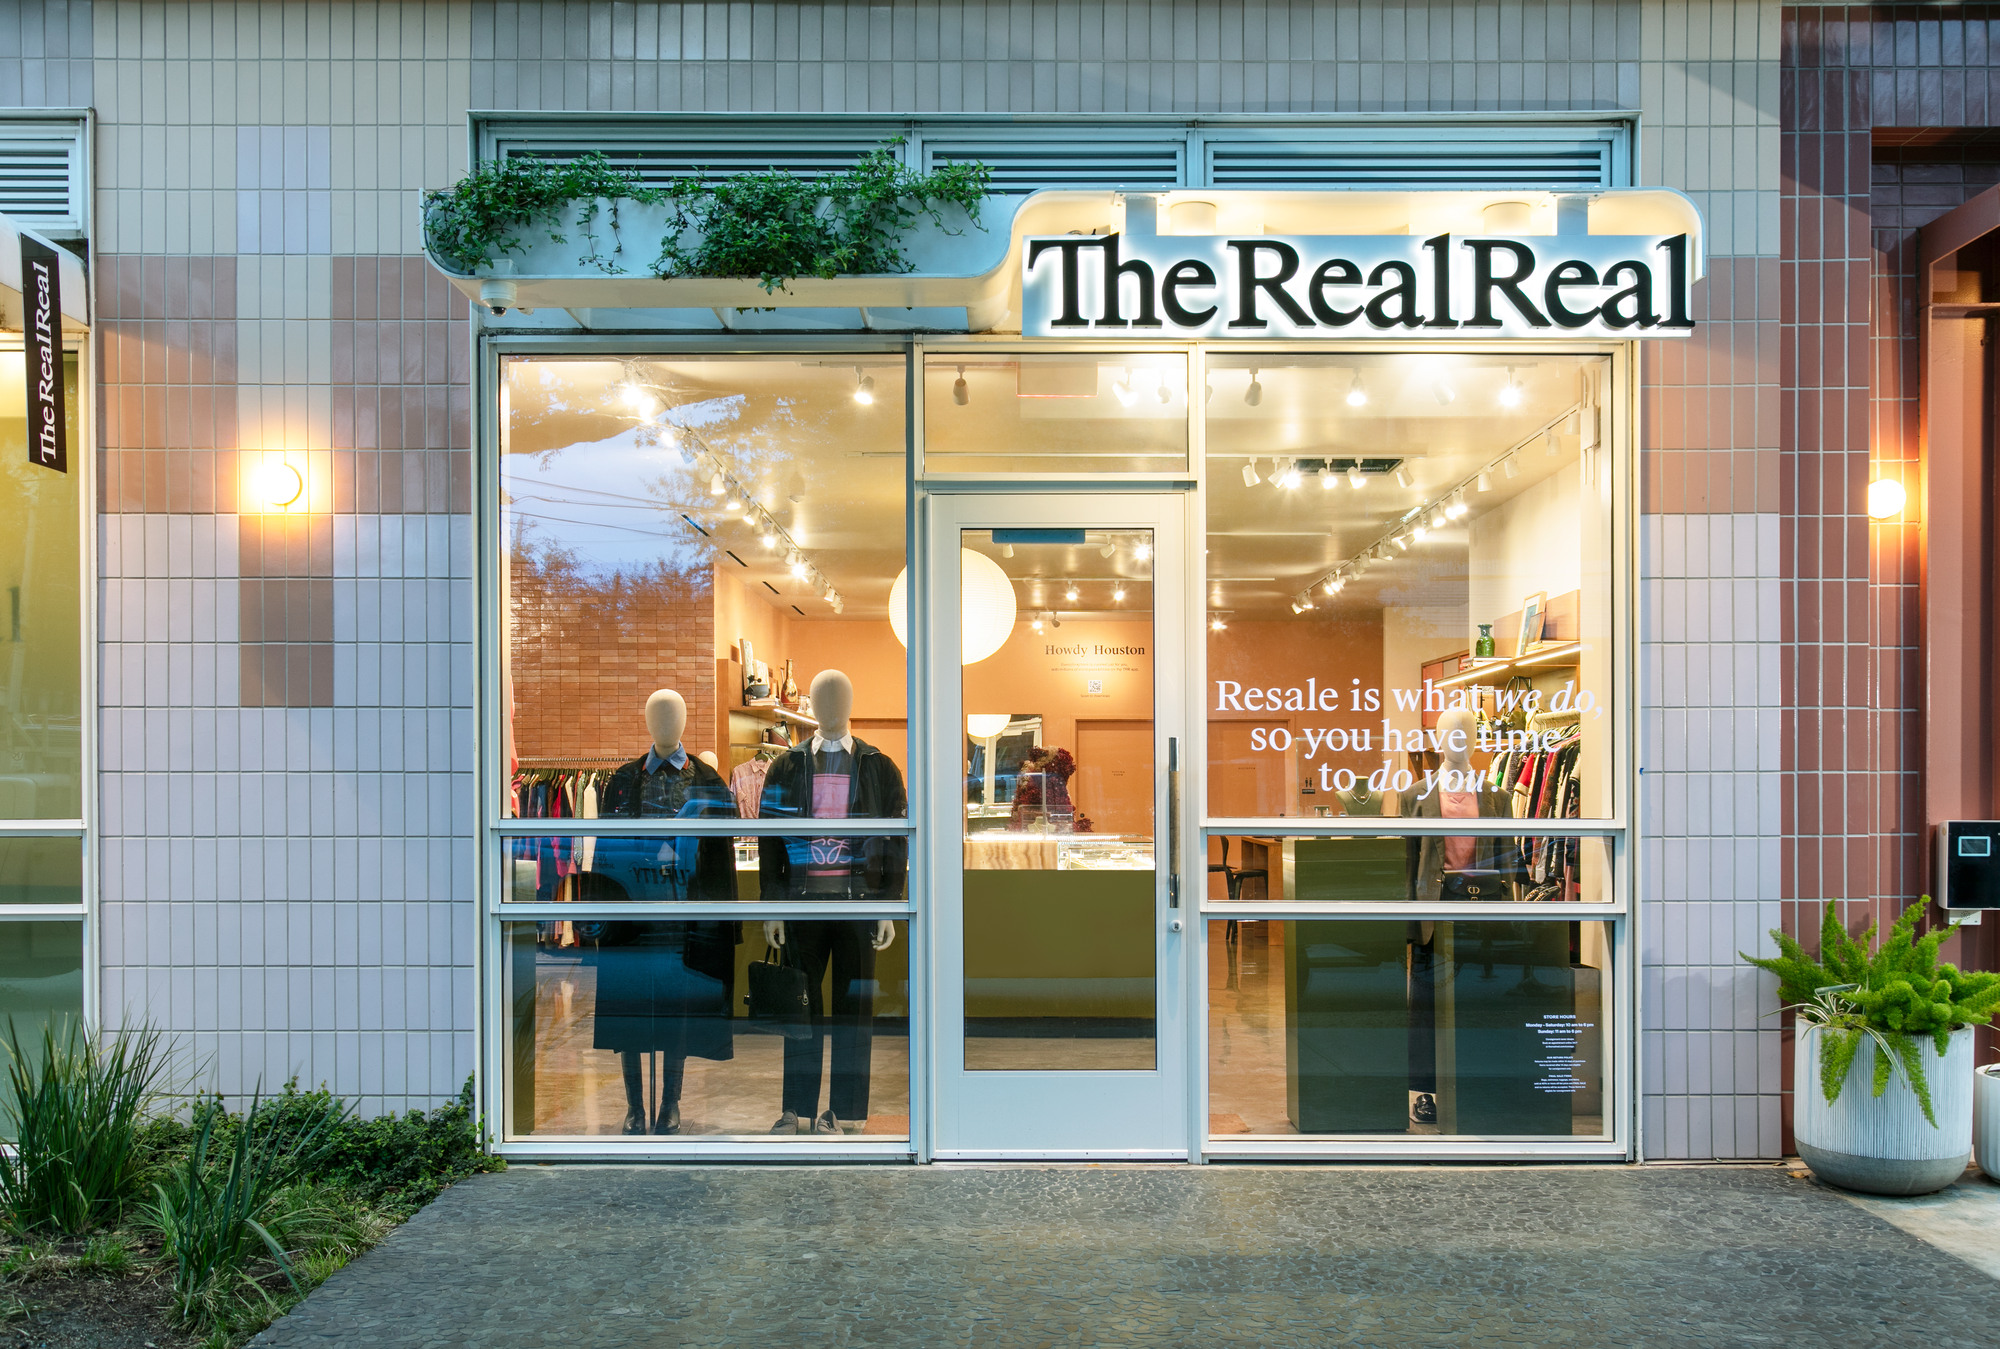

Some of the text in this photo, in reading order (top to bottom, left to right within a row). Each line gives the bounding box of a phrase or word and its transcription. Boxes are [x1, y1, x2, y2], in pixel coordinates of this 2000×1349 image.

[1027, 231, 1695, 331] TheRealReal
[1045, 644, 1145, 657] Howdy Houston
[1216, 678, 1603, 720] Resale is what we do,
[1251, 719, 1561, 759] so you have time
[1319, 762, 1356, 792] to
[1368, 760, 1413, 792] do
